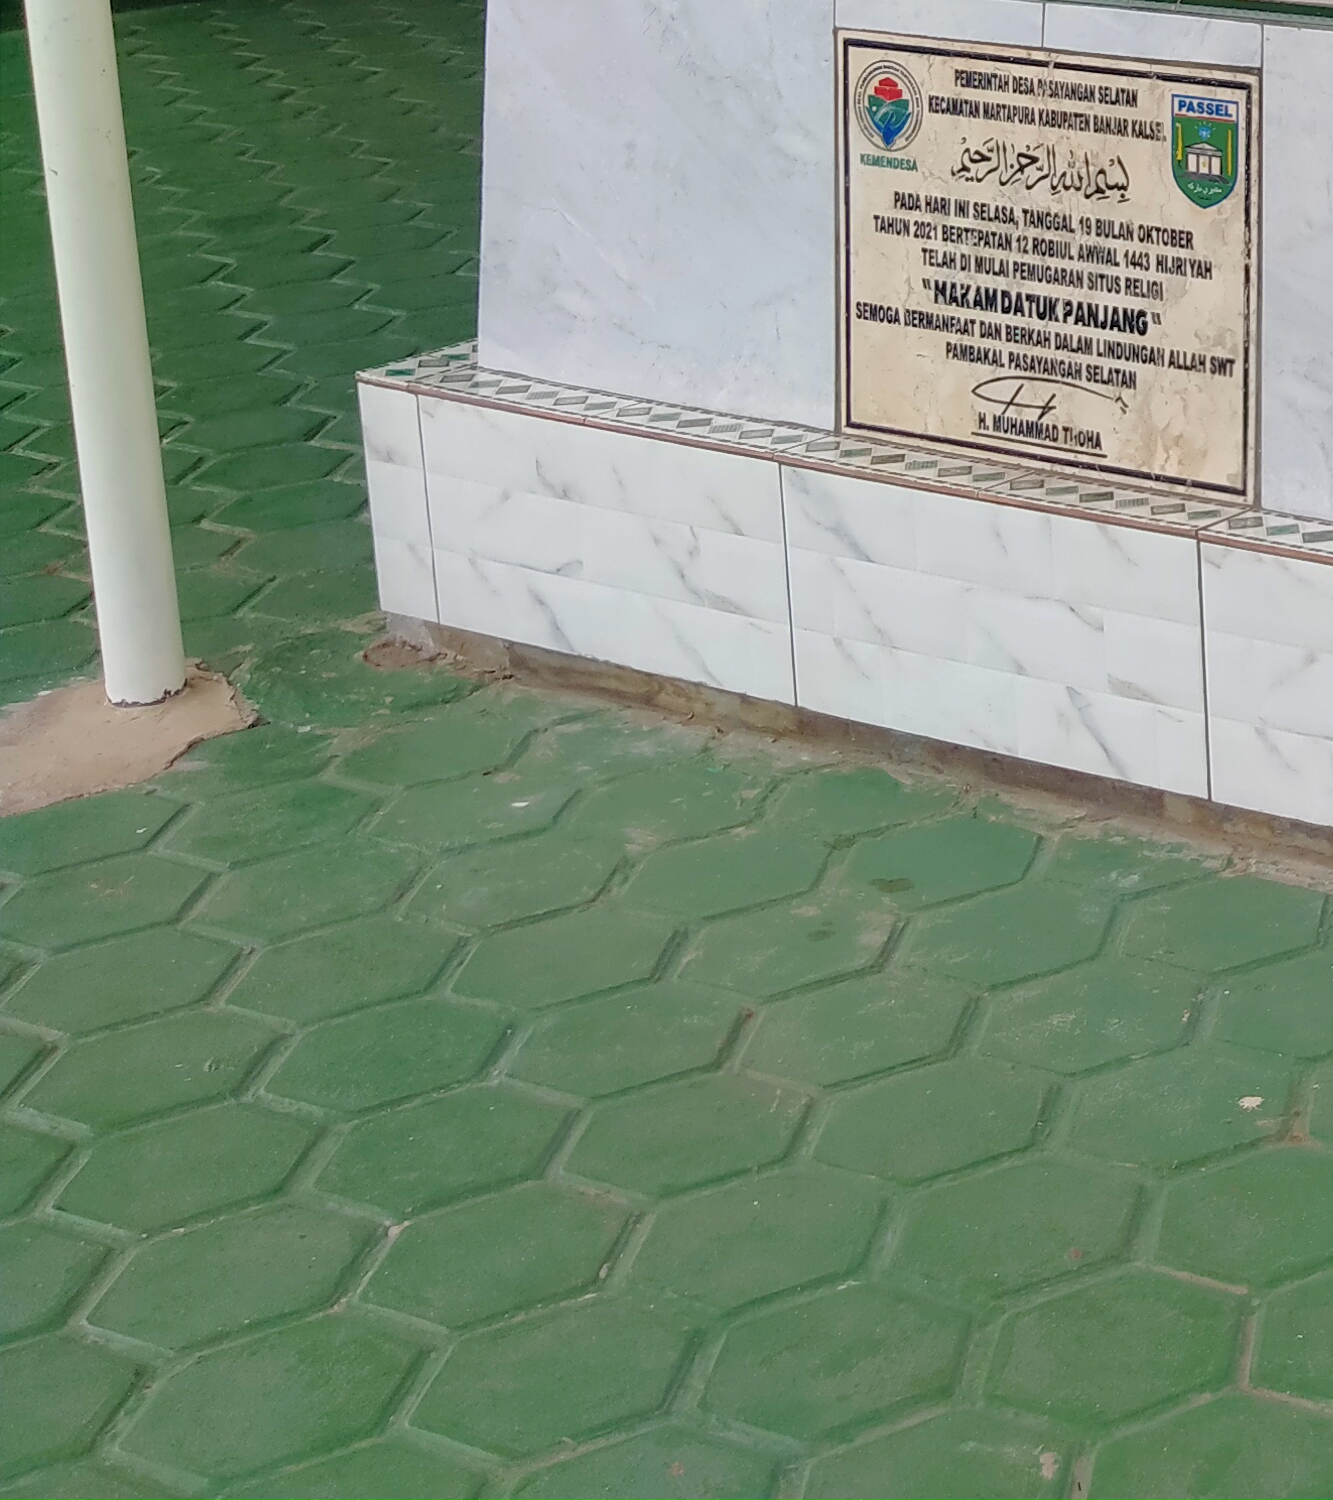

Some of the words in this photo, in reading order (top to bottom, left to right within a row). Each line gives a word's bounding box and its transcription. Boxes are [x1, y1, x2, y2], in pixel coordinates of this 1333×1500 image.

[954, 68, 1010, 93] PEMERINTAH
[1012, 75, 1036, 97] DESA
[1098, 84, 1138, 108] SELATAN
[1178, 99, 1233, 118] PASSEL
[928, 94, 980, 119] KECAMATAN
[982, 100, 1037, 126] MARTAPURA
[1038, 108, 1092, 133] KABUPATEN
[1093, 114, 1130, 138] BANJAR
[859, 152, 919, 172] KEMENDESA
[893, 190, 922, 213] PADA
[924, 194, 951, 217] HARI
[954, 198, 970, 219] INI
[973, 201, 1019, 230] SELASA,
[1022, 207, 1076, 234] TANGGAL
[1079, 215, 1092, 236] 19
[1095, 217, 1134, 242] BULAN
[1137, 223, 1194, 250] OKTOBER
[873, 214, 911, 238] TAHUN
[913, 219, 938, 241] 2021
[942, 224, 1013, 252] BERTEPATAN
[1016, 234, 1029, 255] 12
[1032, 236, 1074, 261] ROBIUL
[1077, 242, 1121, 268] AWWAL
[1123, 249, 1150, 272] 1443
[921, 247, 957, 271] TELAH
[960, 253, 971, 273] DI
[974, 255, 1010, 279] MULAI
[1013, 260, 1084, 289] PEMUGARAN
[1087, 271, 1122, 295] SITUS
[1124, 276, 1164, 302] RELIGI
[1001, 288, 1060, 323] DATUK
[855, 300, 901, 326] SEMOGA
[903, 308, 977, 337] BERMANFAAT
[979, 319, 1002, 342] DAN
[1005, 323, 1052, 350] BERKAH
[1054, 331, 1093, 356] DALAM
[1096, 338, 1165, 368] LINDUNGAN
[1167, 349, 1207, 373] ALLAH
[1209, 355, 1236, 378] SWT
[945, 341, 1006, 368] PAMBAKAL
[1008, 350, 1083, 381] PASAYANGAN
[1085, 362, 1137, 390] SELATAN
[978, 411, 990, 431] H.
[993, 414, 1059, 442] MUHAMMAD
